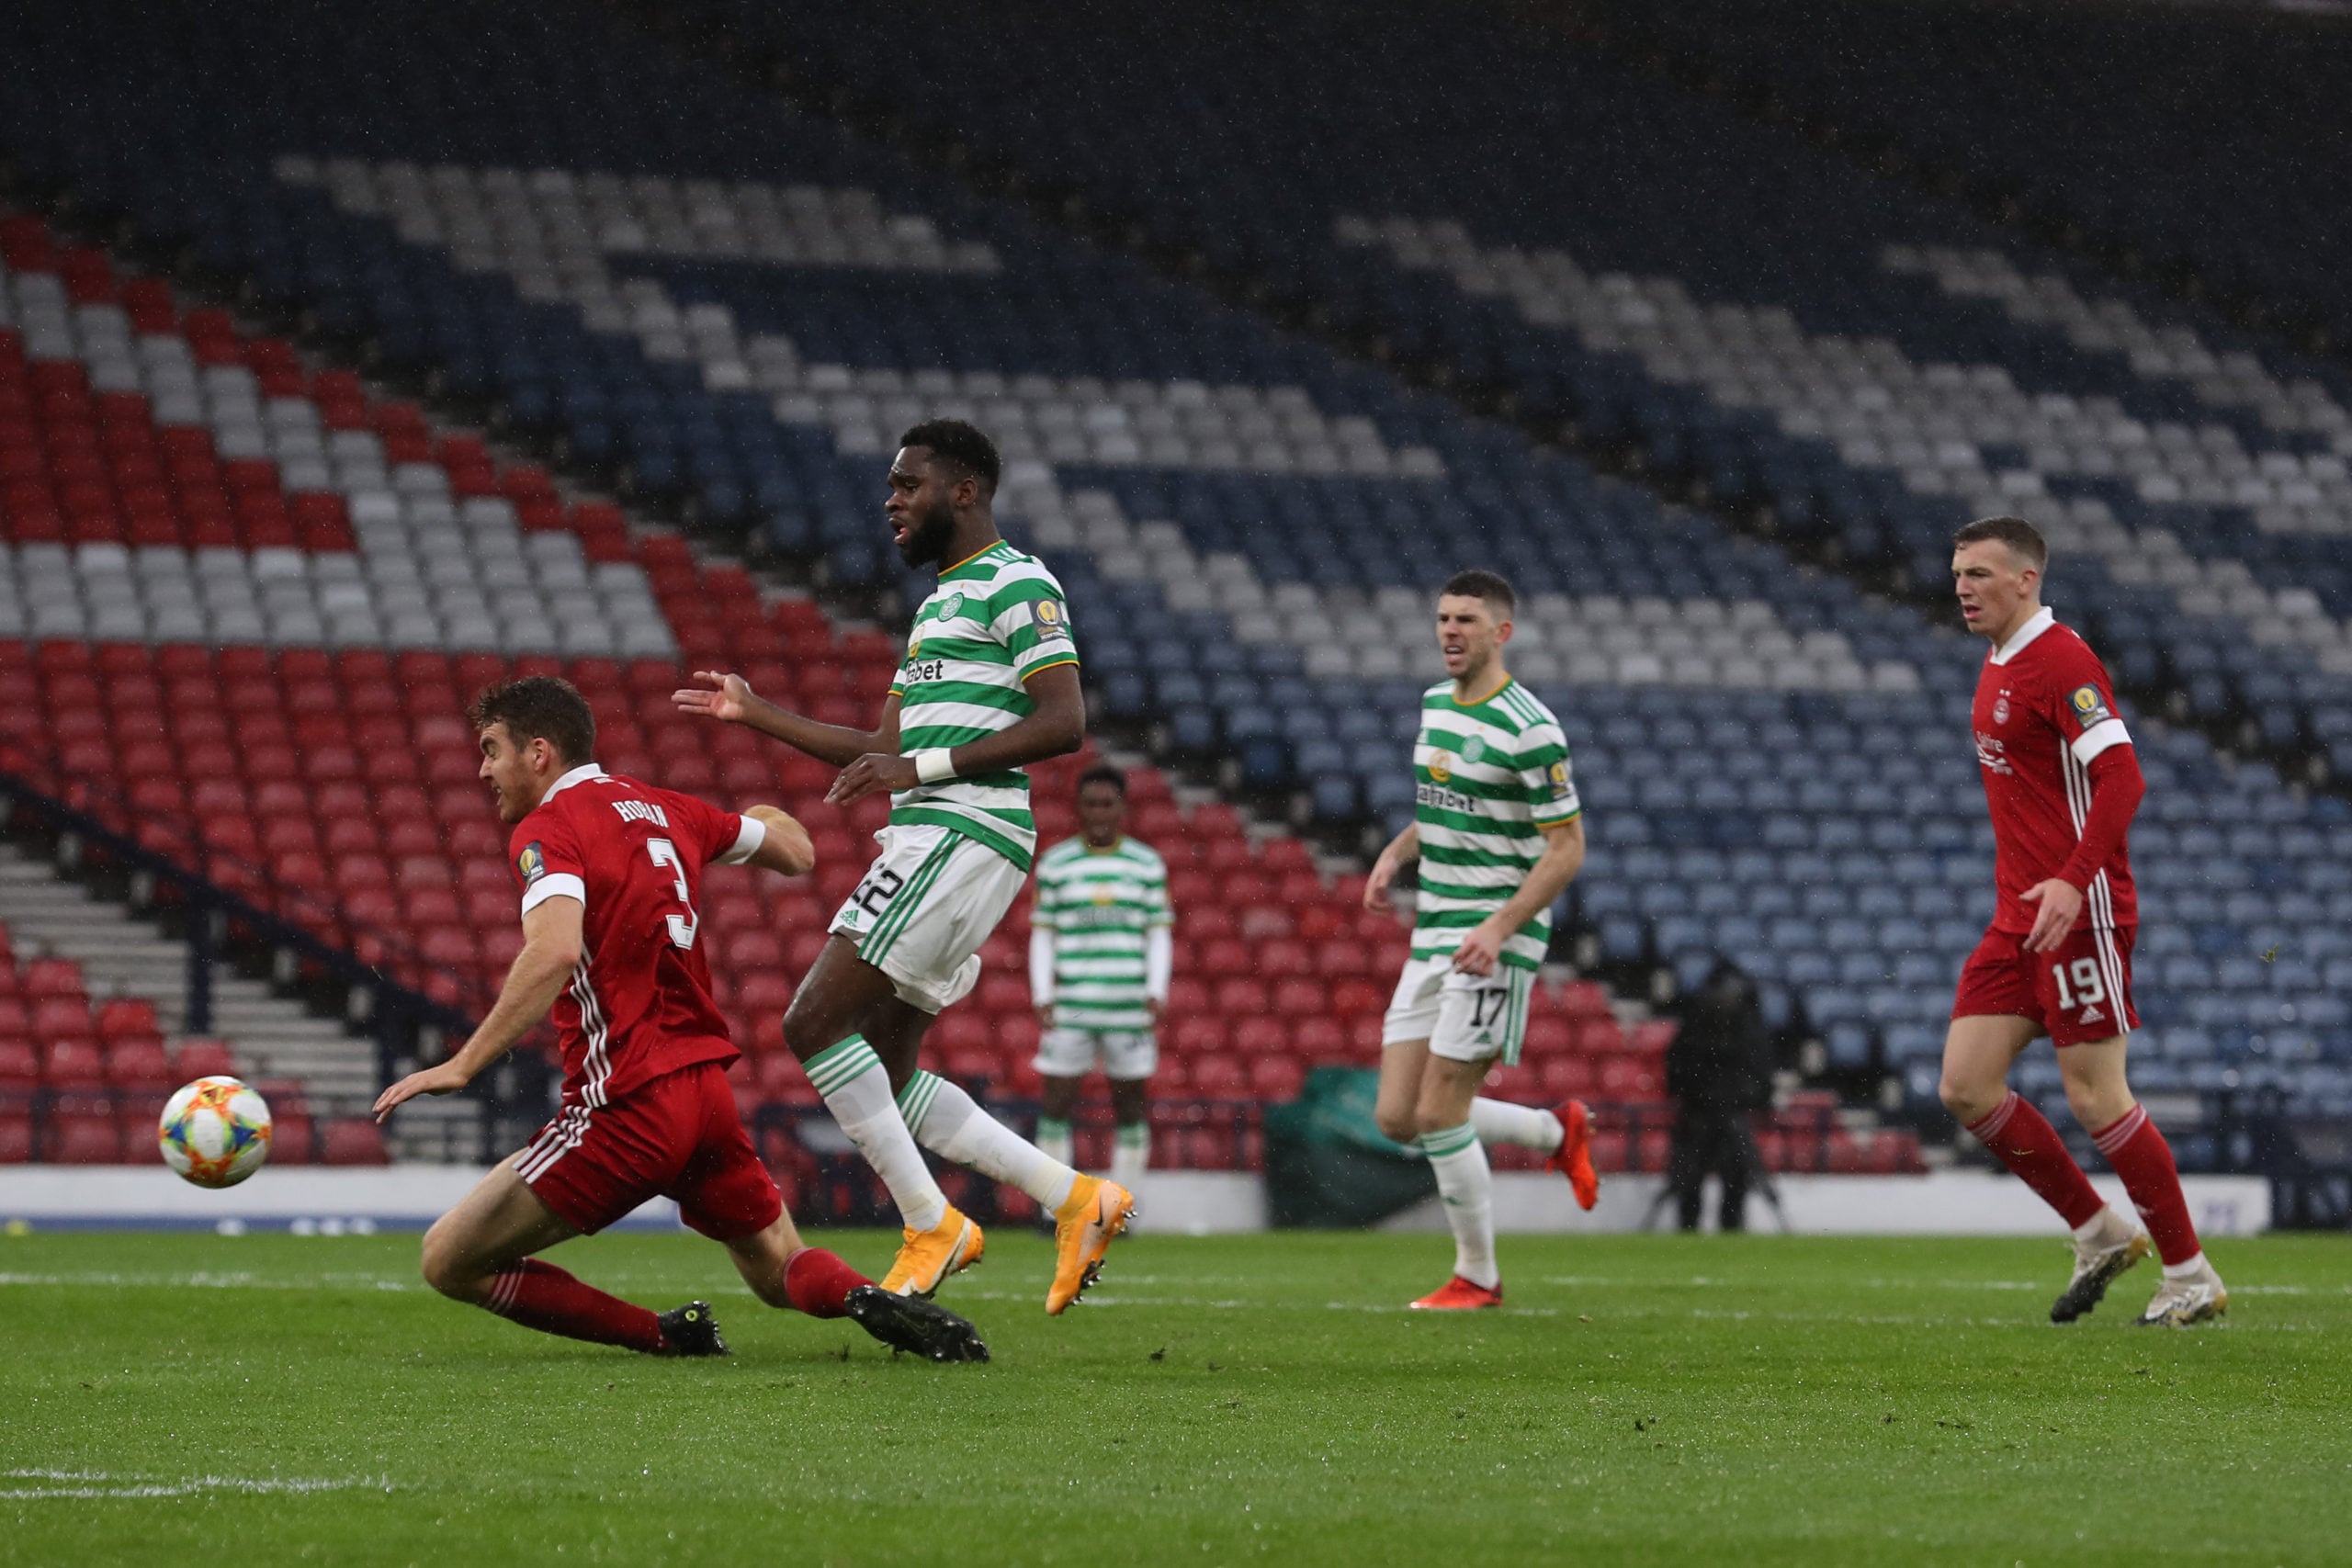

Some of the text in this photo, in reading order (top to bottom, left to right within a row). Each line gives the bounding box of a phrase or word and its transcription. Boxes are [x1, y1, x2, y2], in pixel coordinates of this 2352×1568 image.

[646, 837, 698, 951] 3
[1470, 987, 1508, 1026] 17
[2052, 956, 2105, 1010] 19
